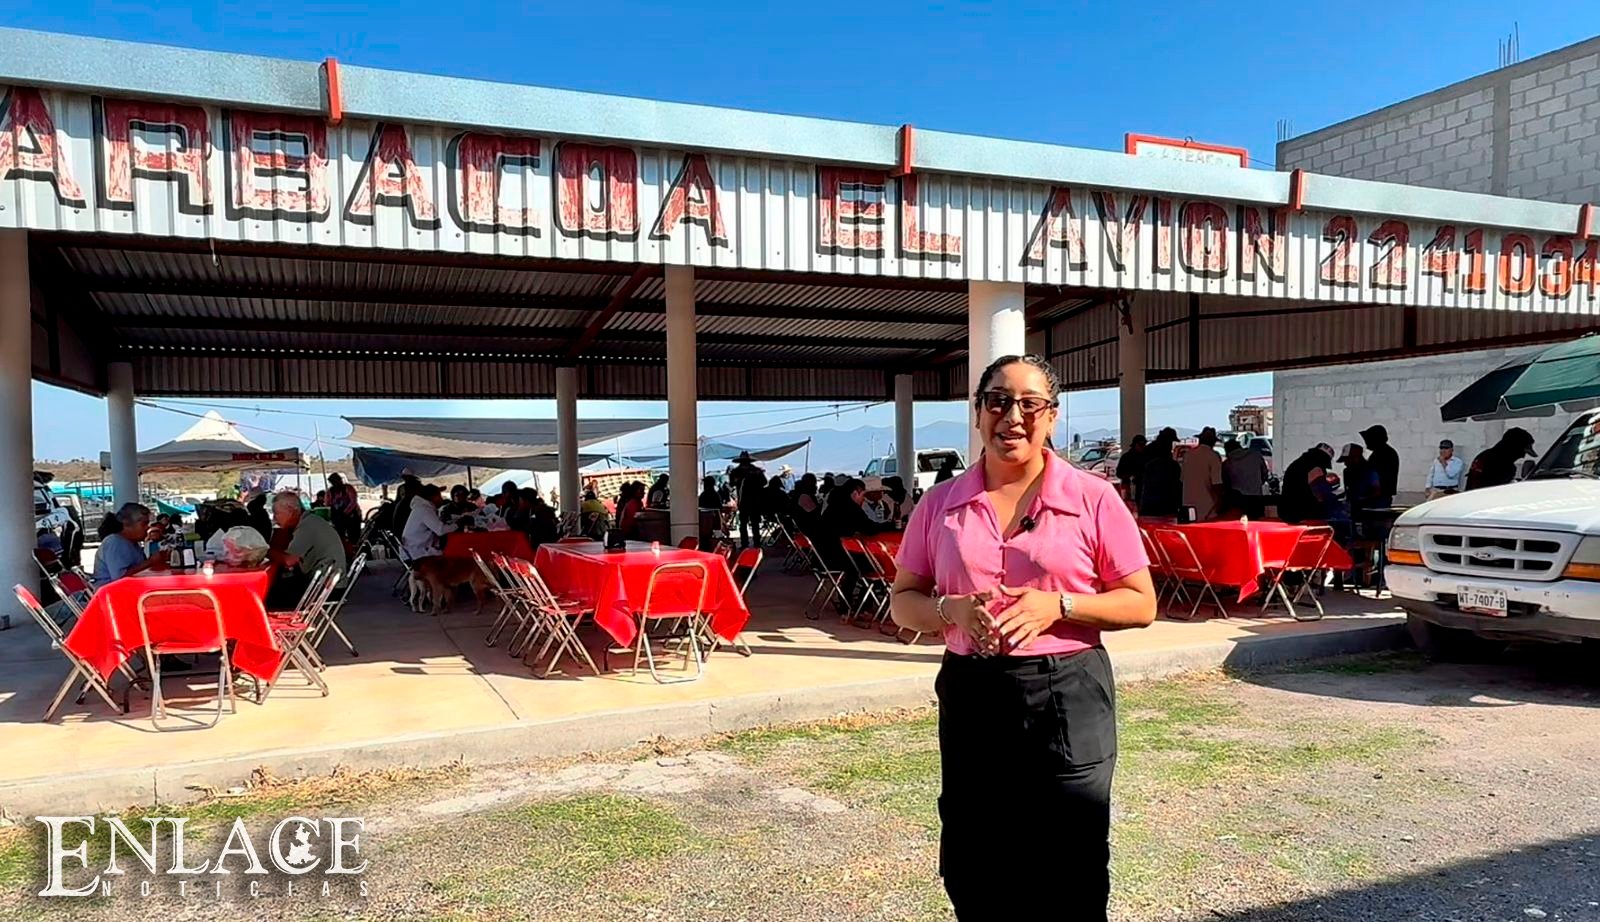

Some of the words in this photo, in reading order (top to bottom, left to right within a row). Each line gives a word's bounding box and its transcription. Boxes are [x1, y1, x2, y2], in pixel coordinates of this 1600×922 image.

[0, 85, 729, 249] ARBACOA
[816, 164, 961, 263] EL
[1018, 185, 1289, 284] AVION
